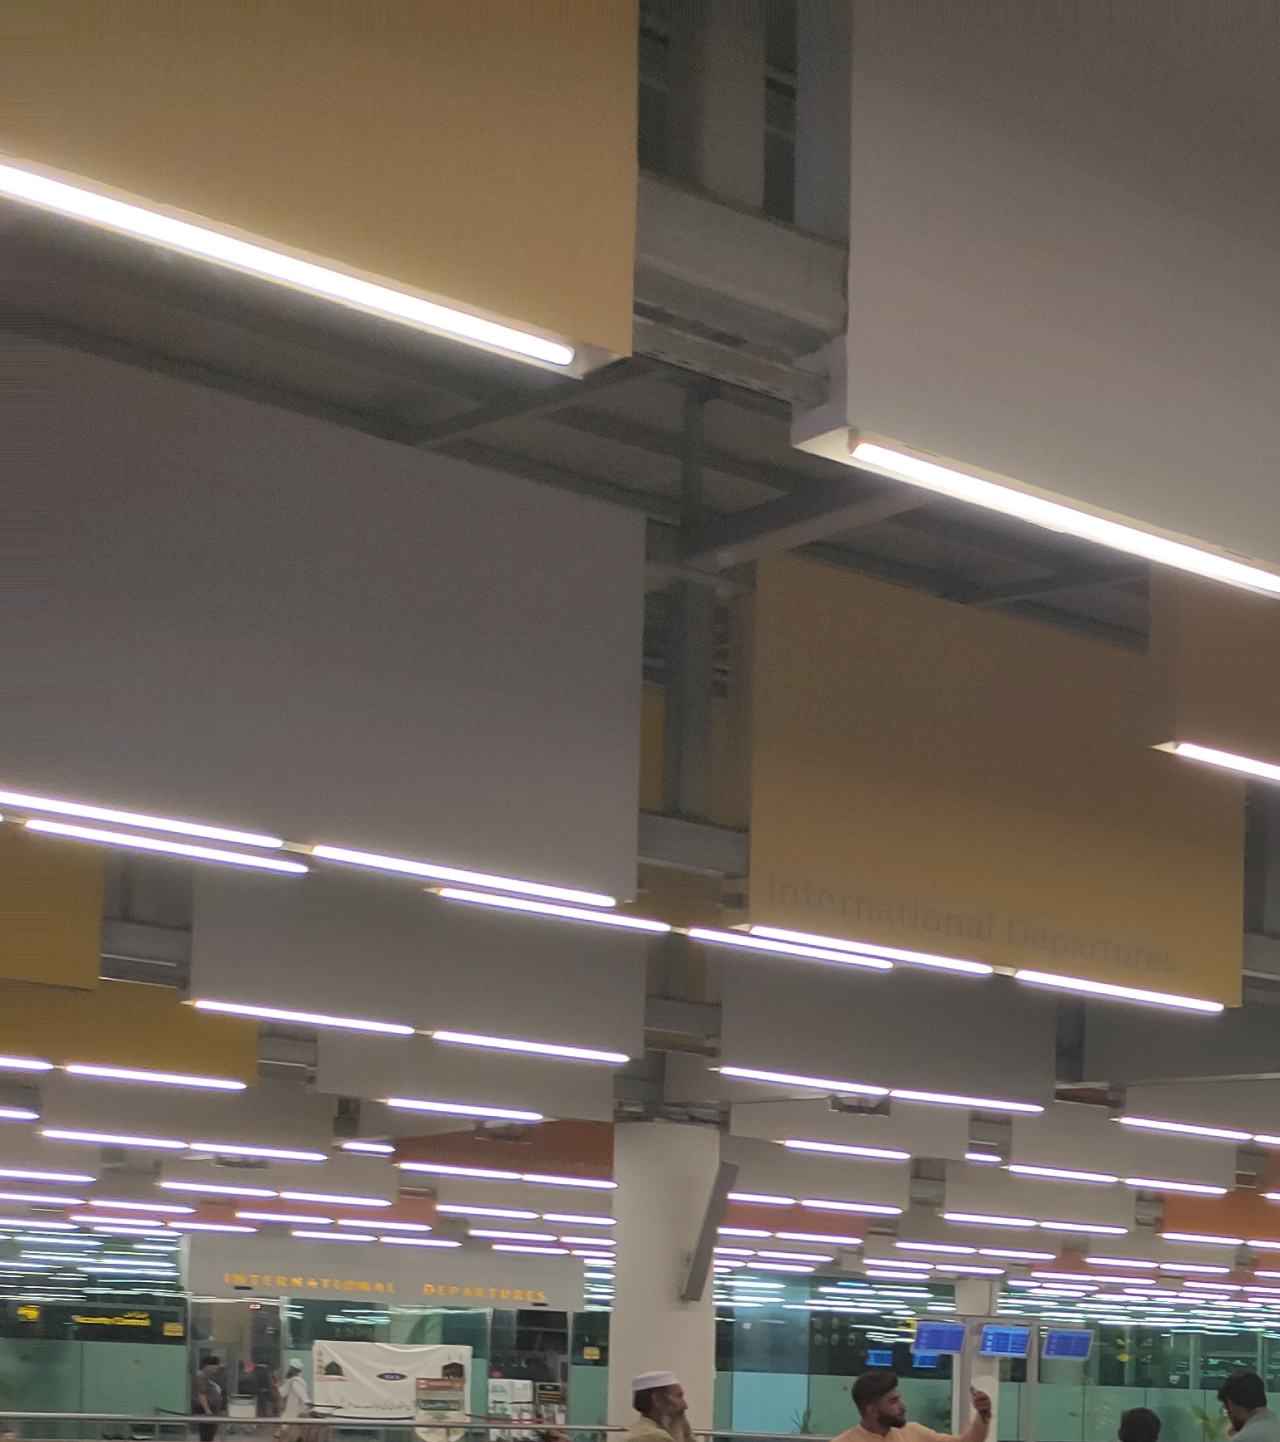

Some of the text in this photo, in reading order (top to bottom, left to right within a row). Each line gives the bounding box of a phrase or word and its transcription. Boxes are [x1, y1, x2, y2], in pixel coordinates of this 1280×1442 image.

[769, 871, 1177, 974] International Departures
[223, 1272, 547, 1302] INTERNATIONAL DEPARTURES
